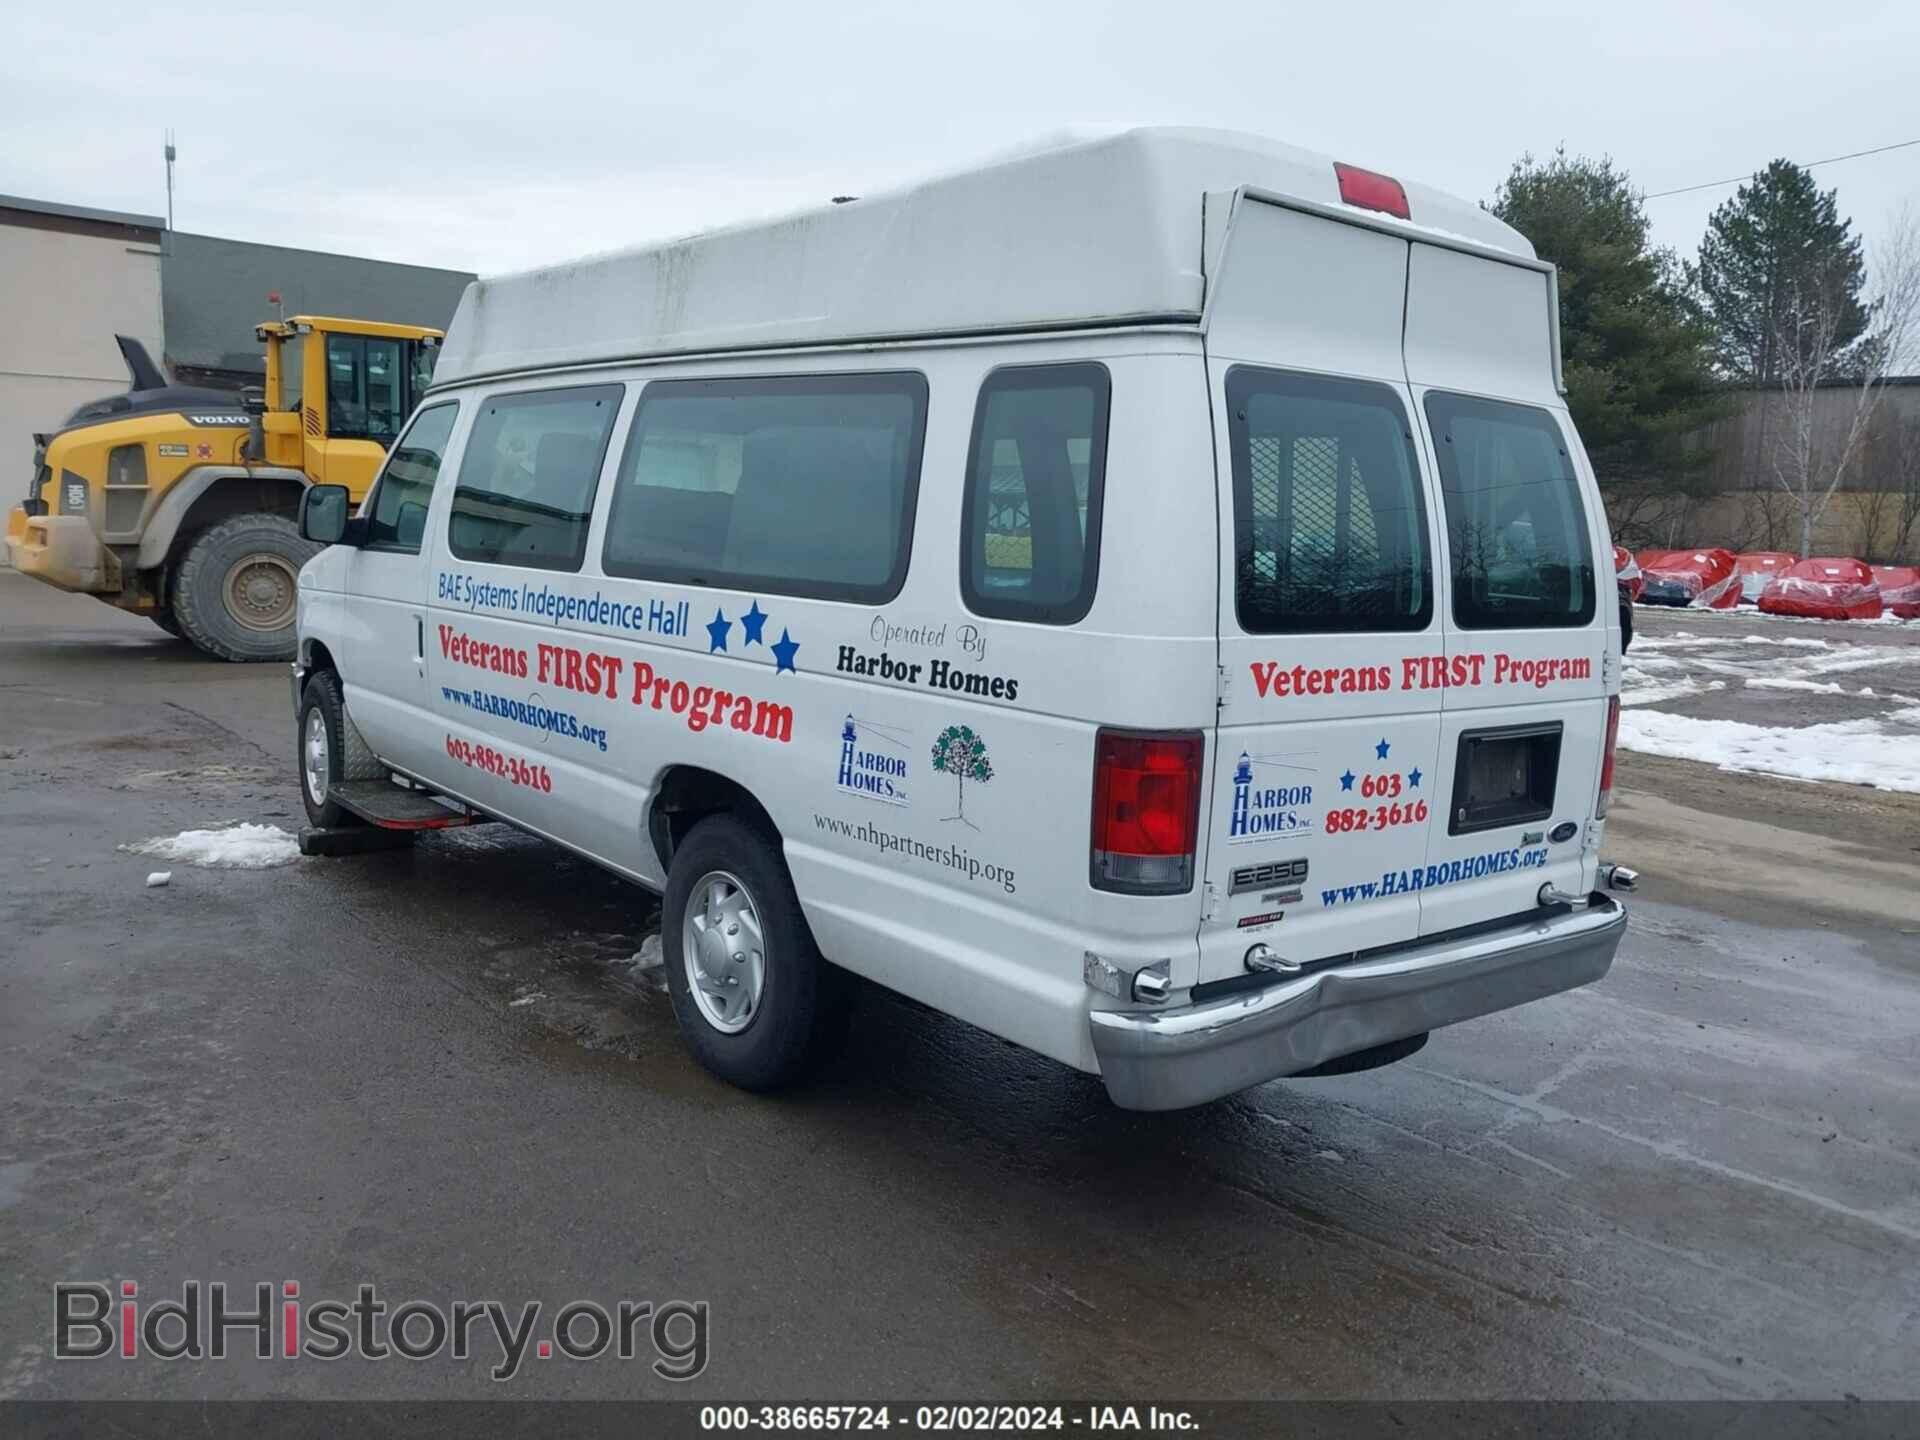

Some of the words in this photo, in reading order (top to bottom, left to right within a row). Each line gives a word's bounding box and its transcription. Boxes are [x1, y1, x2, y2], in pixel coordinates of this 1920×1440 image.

[192, 415, 251, 425] VOLVO
[439, 572, 463, 601] BAE
[465, 576, 518, 612] Systems
[521, 584, 643, 630] Independence
[648, 600, 690, 637] Hall
[870, 615, 947, 648] Operated
[956, 624, 987, 661] By
[438, 623, 528, 679] Veterans
[537, 643, 623, 700] FIRST
[631, 662, 793, 742] Program
[837, 645, 922, 684] Harbor
[928, 659, 1019, 700] Homes
[1250, 662, 1391, 698] Veterans
[1401, 654, 1486, 691] FIRST
[1492, 655, 1591, 688] Program
[441, 685, 608, 752] www.HARBORHOMES.org
[446, 733, 552, 793] 603-882-3616
[838, 763, 894, 797] HOMES
[842, 741, 907, 778] HARBOR
[1234, 785, 1312, 810] HARBOR
[1361, 773, 1402, 799] 603
[1230, 810, 1297, 837] HOMES
[1325, 799, 1428, 834] 882-3616
[813, 812, 1017, 893] www.nhpartnership.org
[1321, 847, 1549, 908] www.HARBORHOMES.org
